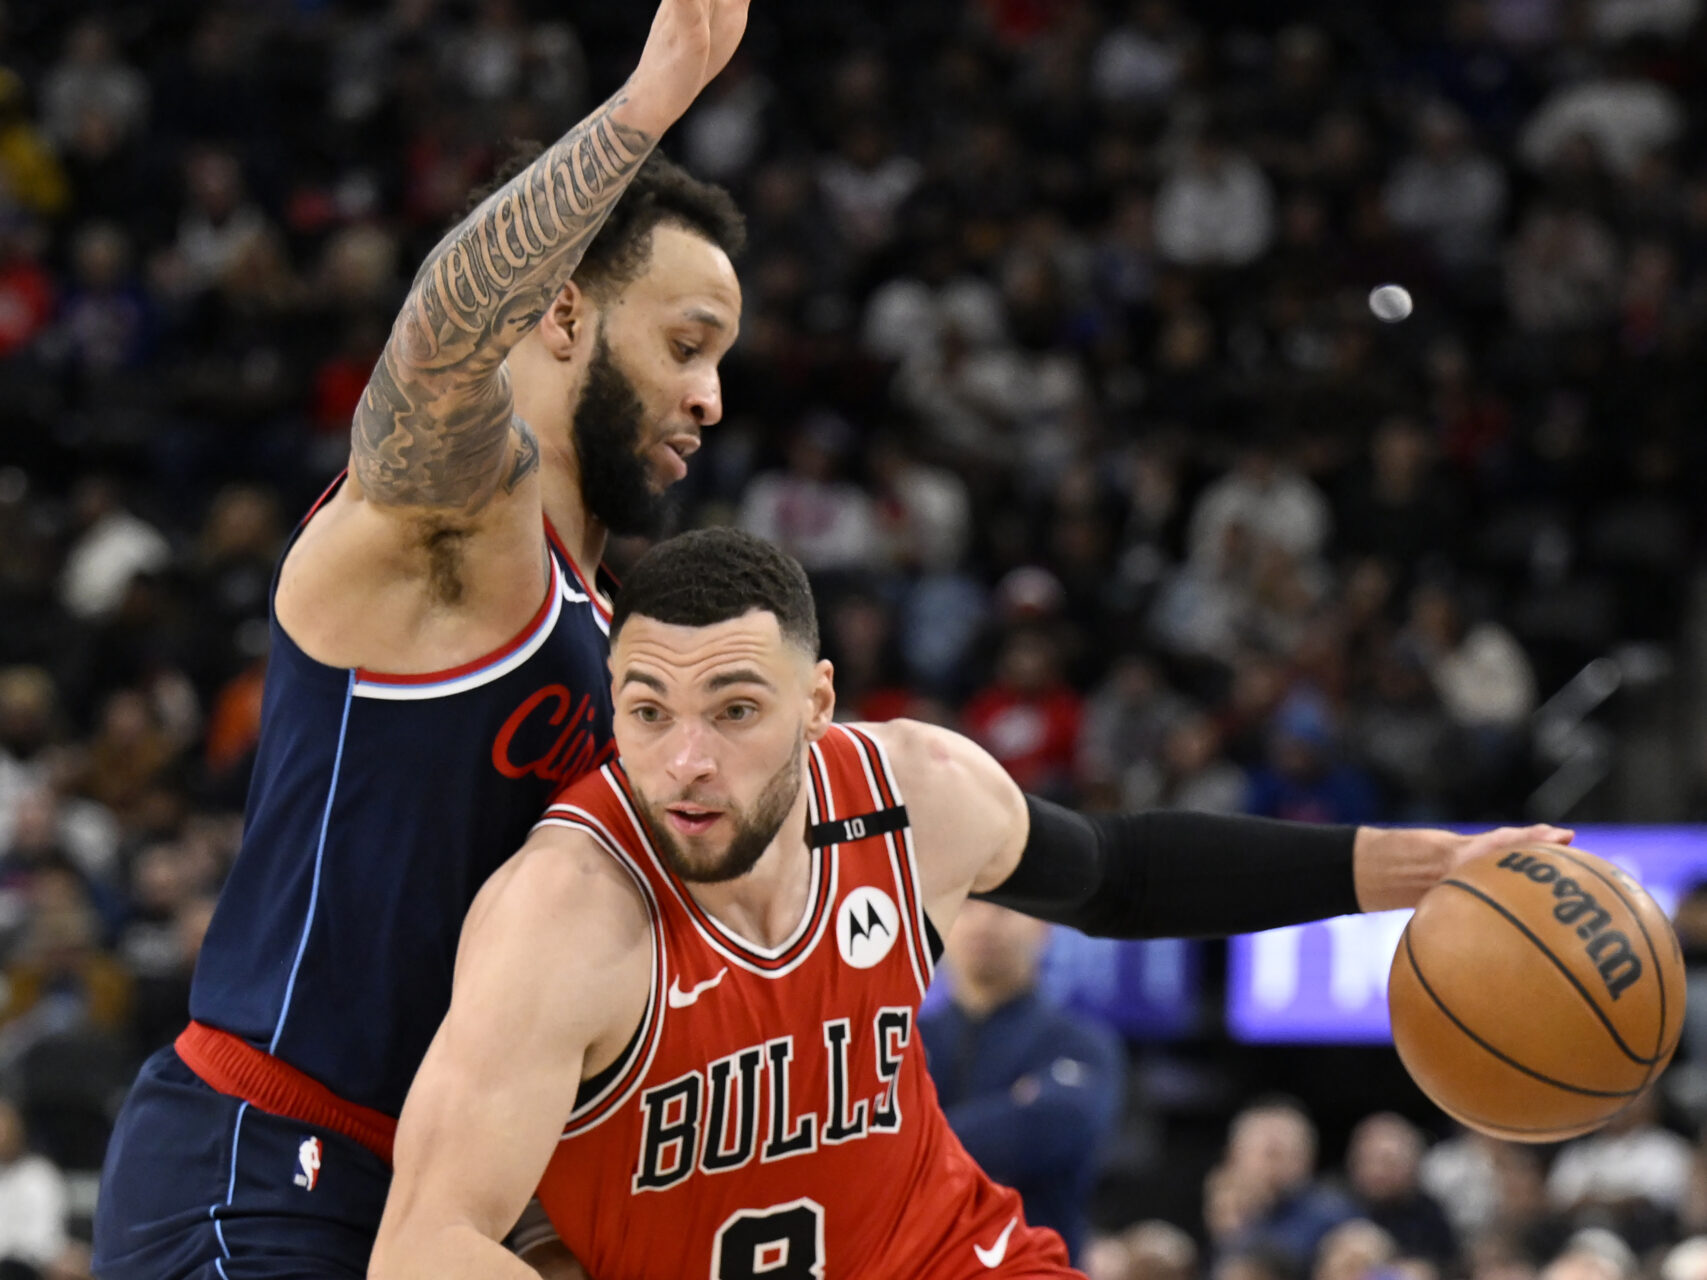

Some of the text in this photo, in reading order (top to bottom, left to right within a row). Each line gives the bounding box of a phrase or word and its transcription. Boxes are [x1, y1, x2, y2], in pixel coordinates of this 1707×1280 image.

[843, 818, 867, 841] 10
[1496, 852, 1643, 1002] Wilson
[631, 1006, 912, 1195] BULLS
